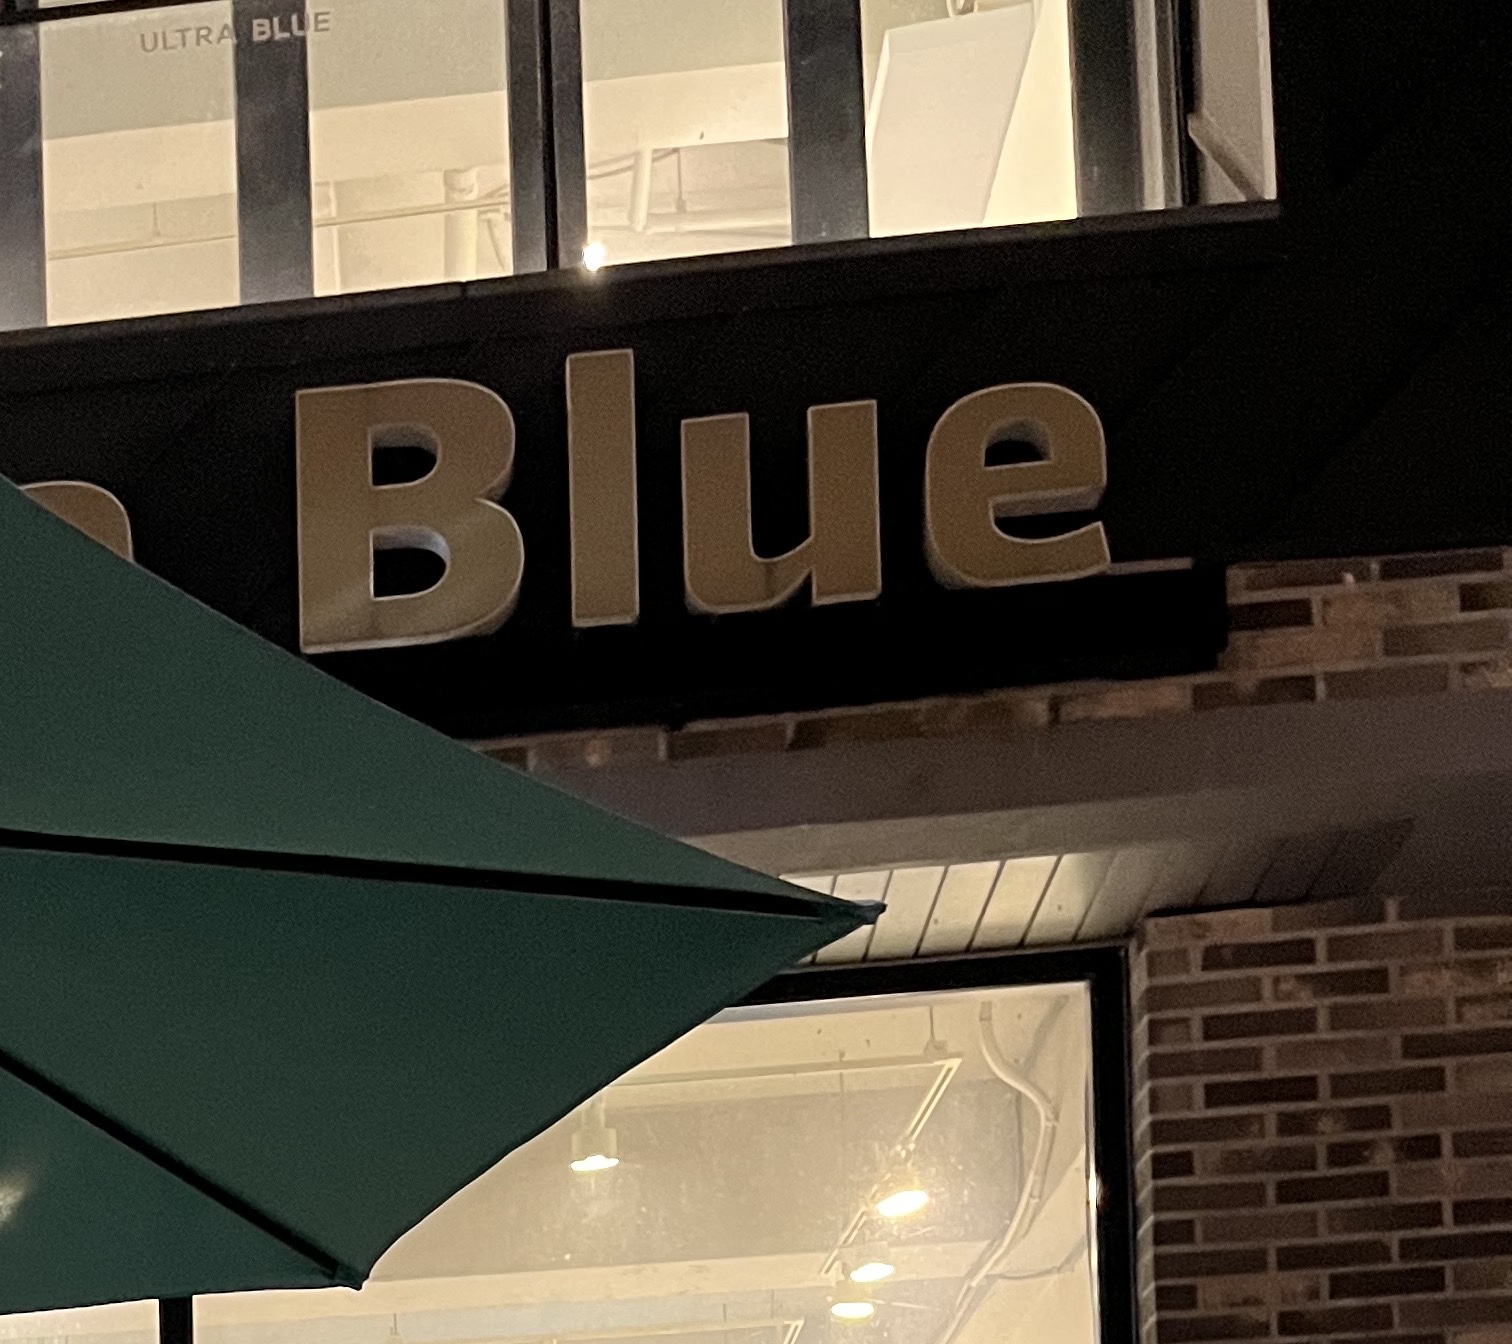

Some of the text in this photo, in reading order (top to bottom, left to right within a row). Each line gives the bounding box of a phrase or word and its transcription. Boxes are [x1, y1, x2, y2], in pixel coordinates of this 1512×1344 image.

[140, 11, 331, 53] ULTRA BLUE
[295, 348, 1111, 655] Blue
